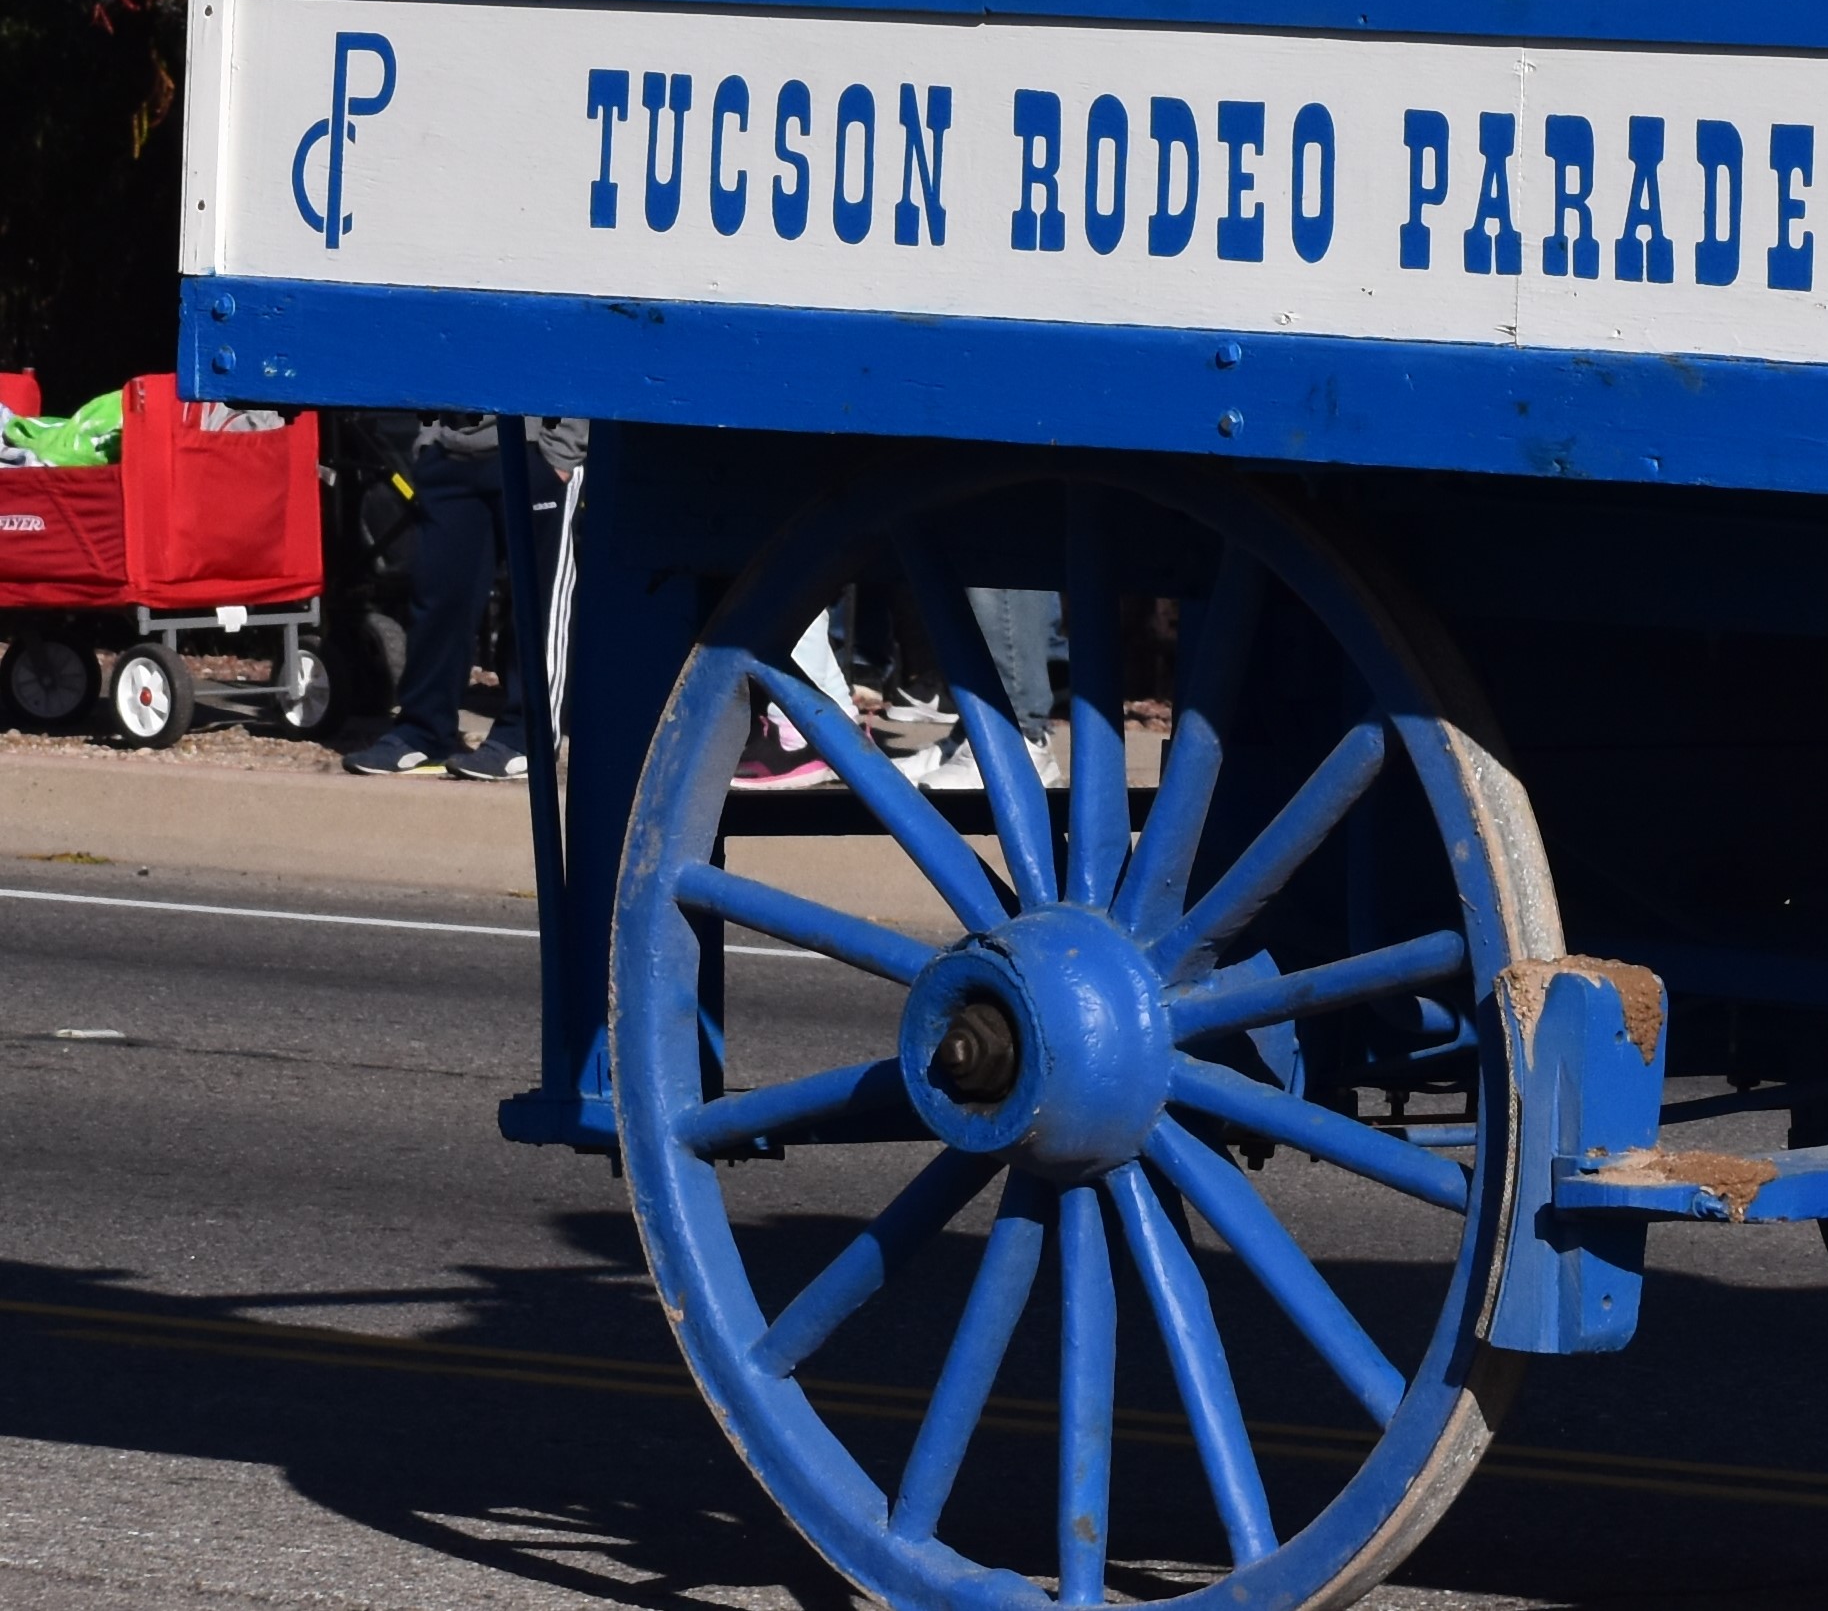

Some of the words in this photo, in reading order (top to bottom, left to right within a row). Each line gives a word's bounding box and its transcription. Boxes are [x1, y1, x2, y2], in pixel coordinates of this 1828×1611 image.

[588, 70, 952, 246] TUCSON
[1012, 90, 1336, 263] RODEO
[1401, 110, 1815, 291] PARADE
